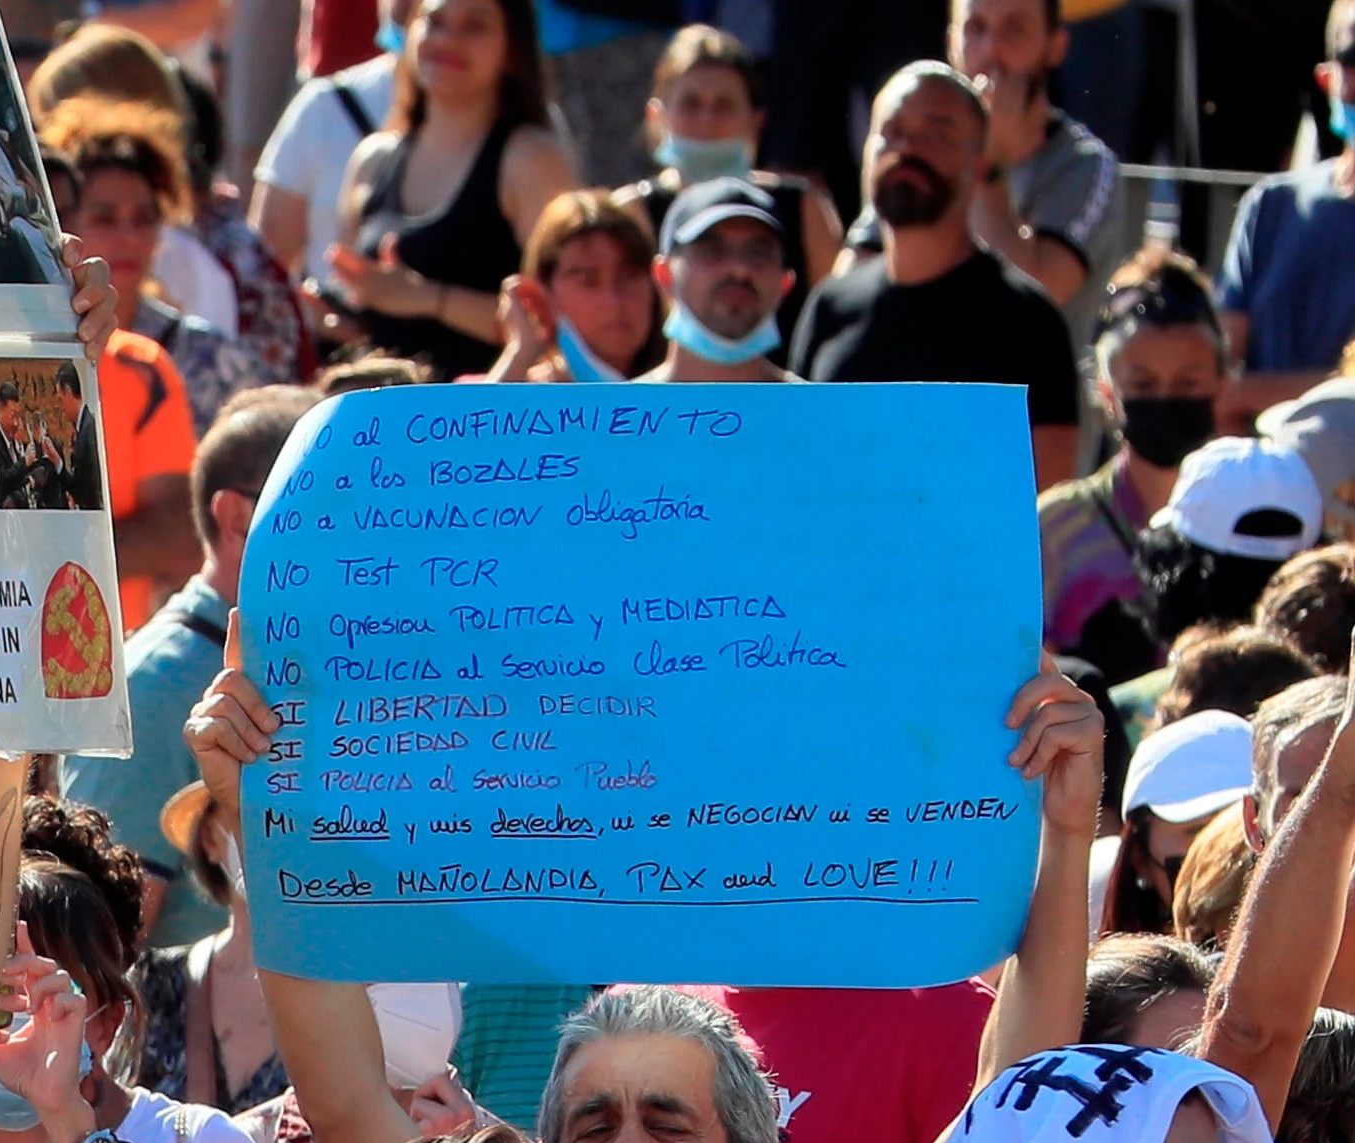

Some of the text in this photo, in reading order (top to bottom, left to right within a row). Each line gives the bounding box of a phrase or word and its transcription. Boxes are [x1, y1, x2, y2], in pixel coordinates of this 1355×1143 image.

[353, 416, 381, 447] al
[281, 454, 580, 499] NO a los BOZALES
[272, 511, 302, 534] NO
[317, 514, 336, 531] a
[354, 503, 542, 530] VACUNACION
[267, 556, 499, 592] NO Test PCR
[266, 612, 300, 644] NO
[449, 604, 574, 633] POLITICA
[622, 595, 787, 625] MEDIATICA
[4, 627, 21, 653] IN
[266, 657, 301, 687] NO
[324, 655, 441, 682] POLICIA
[456, 653, 483, 680] al
[270, 693, 656, 726] SI LIBERTAD DECIDIR
[267, 729, 557, 762] SI SOCIEDAD CIVIL
[266, 773, 303, 794] SI
[320, 769, 413, 793] POLICIA
[429, 764, 457, 793] al
[575, 759, 658, 790] Pueblo
[265, 807, 295, 838] Mi
[311, 805, 389, 836] salud
[403, 822, 417, 844] y
[647, 813, 671, 828] se
[687, 803, 818, 829] NEGOCIAN
[866, 807, 890, 823] se
[906, 797, 1019, 824] VENDEN
[279, 868, 373, 898] Desde
[626, 861, 707, 893] PAX
